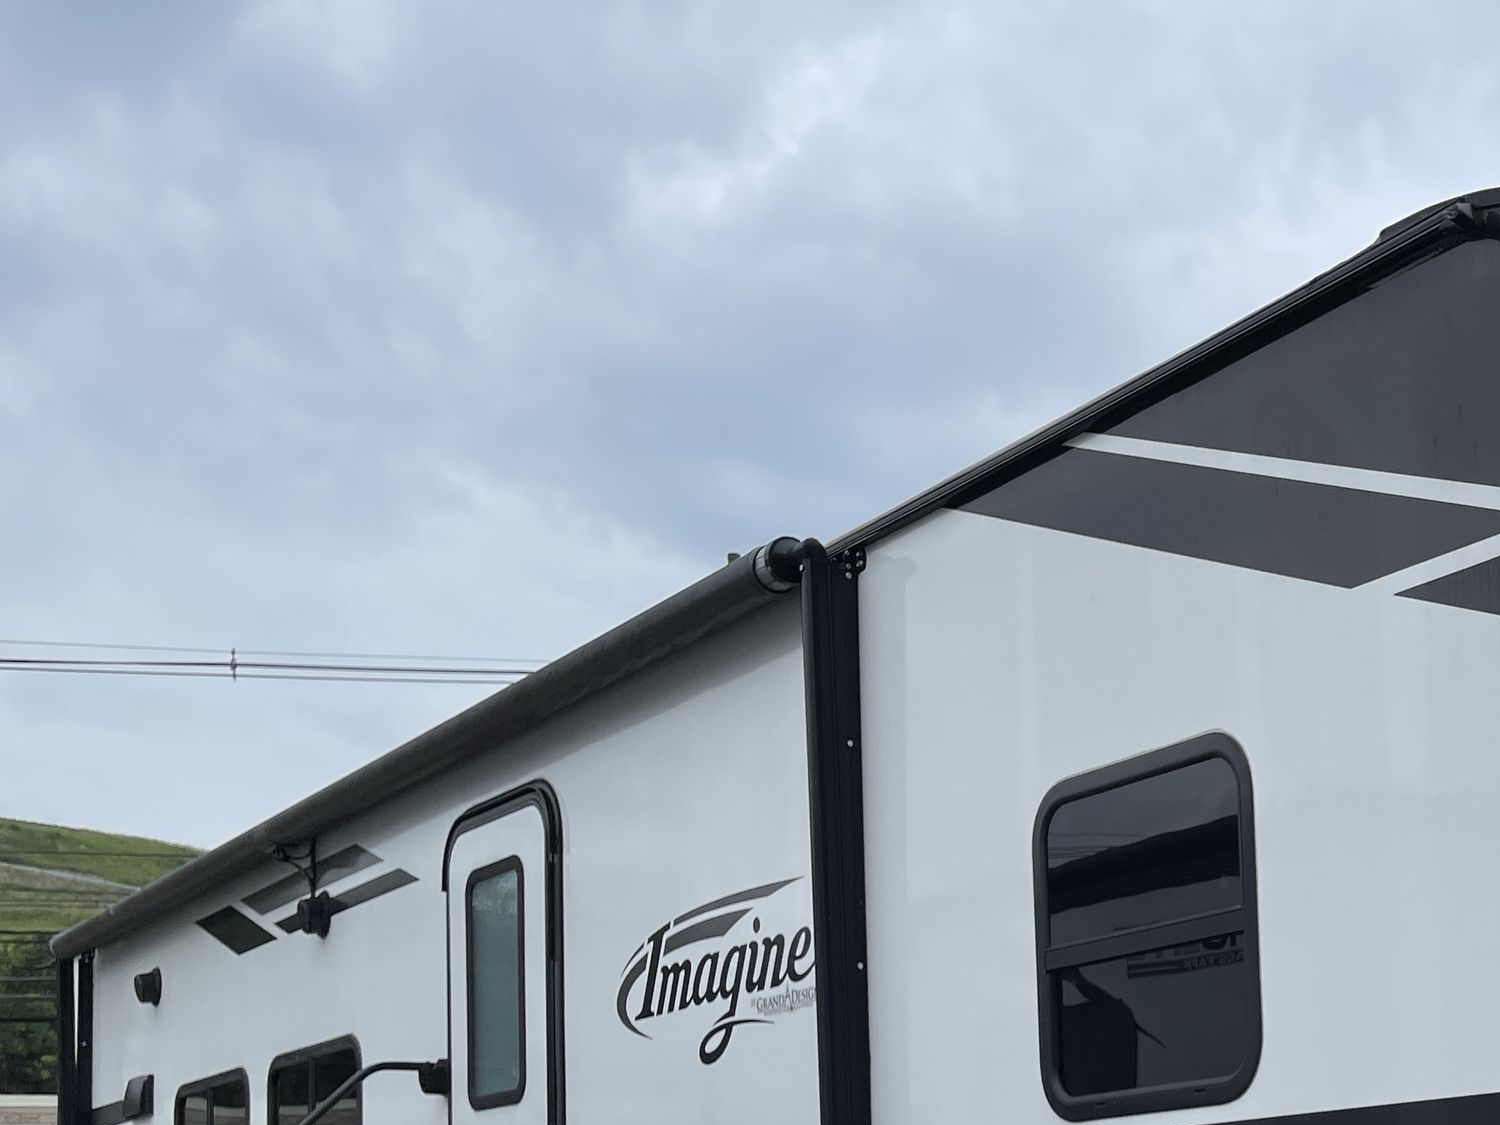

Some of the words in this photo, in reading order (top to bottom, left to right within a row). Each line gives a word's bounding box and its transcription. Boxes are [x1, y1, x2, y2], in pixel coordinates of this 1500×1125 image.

[634, 917, 816, 1065] Imagine
[756, 993, 785, 1012] GRAND
[791, 986, 816, 1004] DESIG
